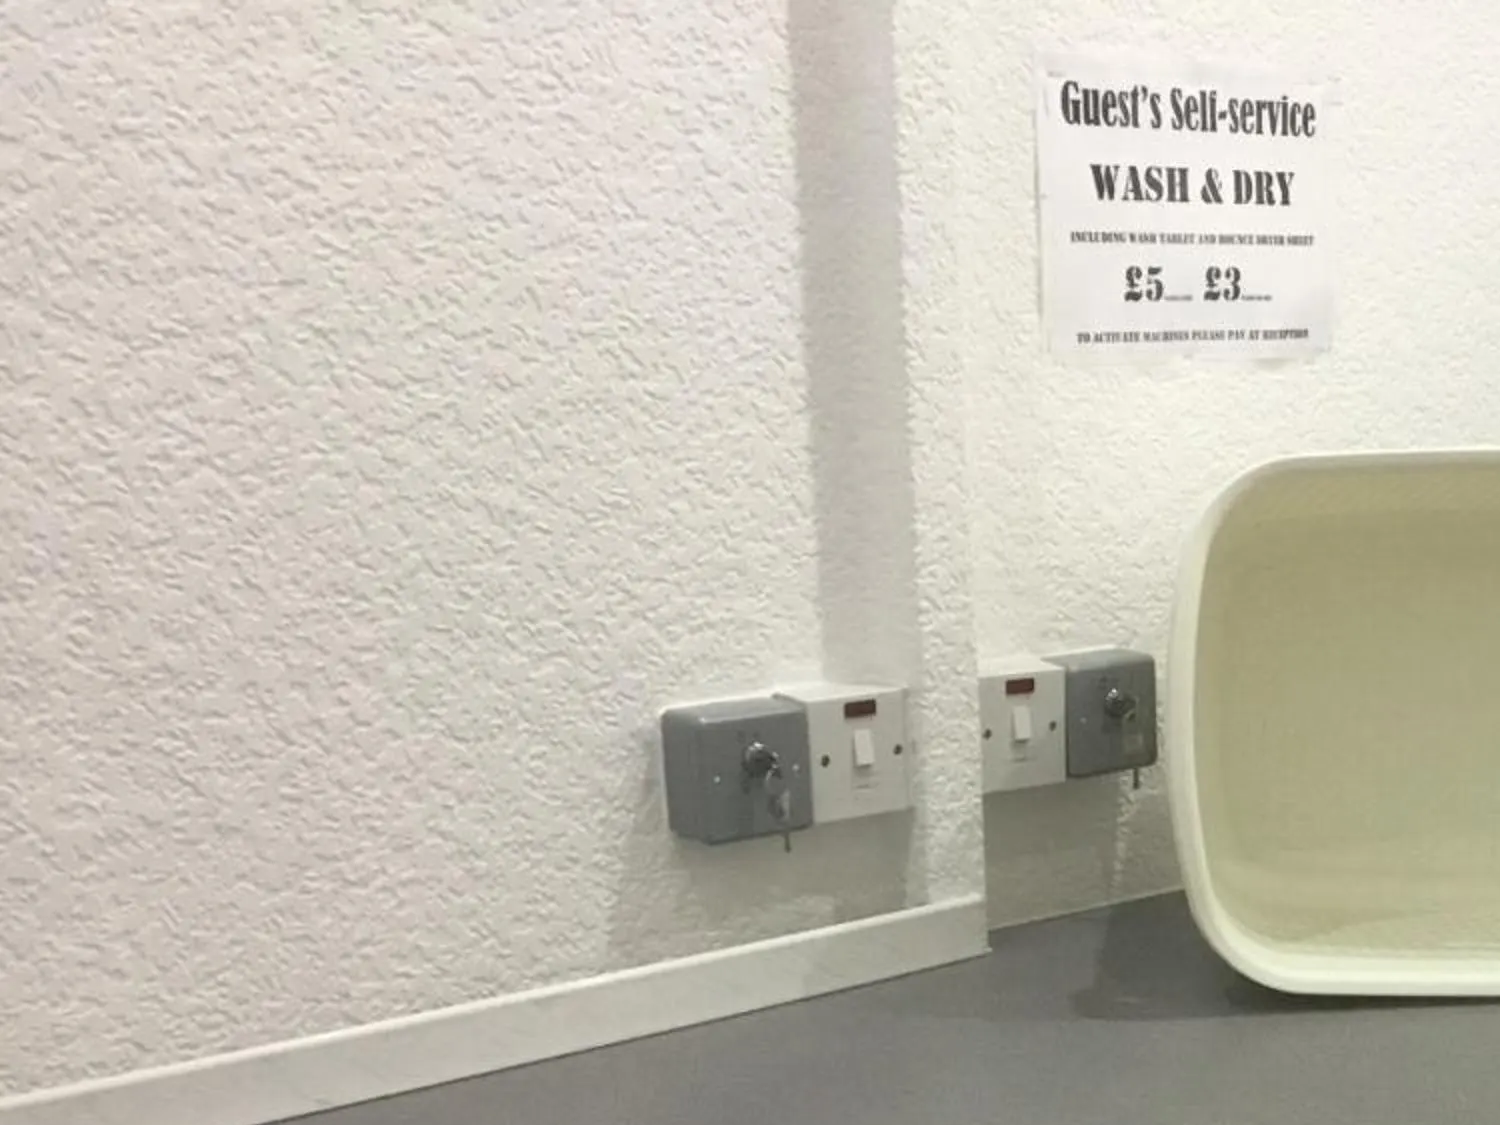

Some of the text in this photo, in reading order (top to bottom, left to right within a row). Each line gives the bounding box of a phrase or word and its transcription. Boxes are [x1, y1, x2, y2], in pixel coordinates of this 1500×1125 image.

[1060, 80, 1316, 137] Guest's Self-service
[1090, 164, 1295, 206] WASH & DRY
[1124, 266, 1241, 301] £5 £3
